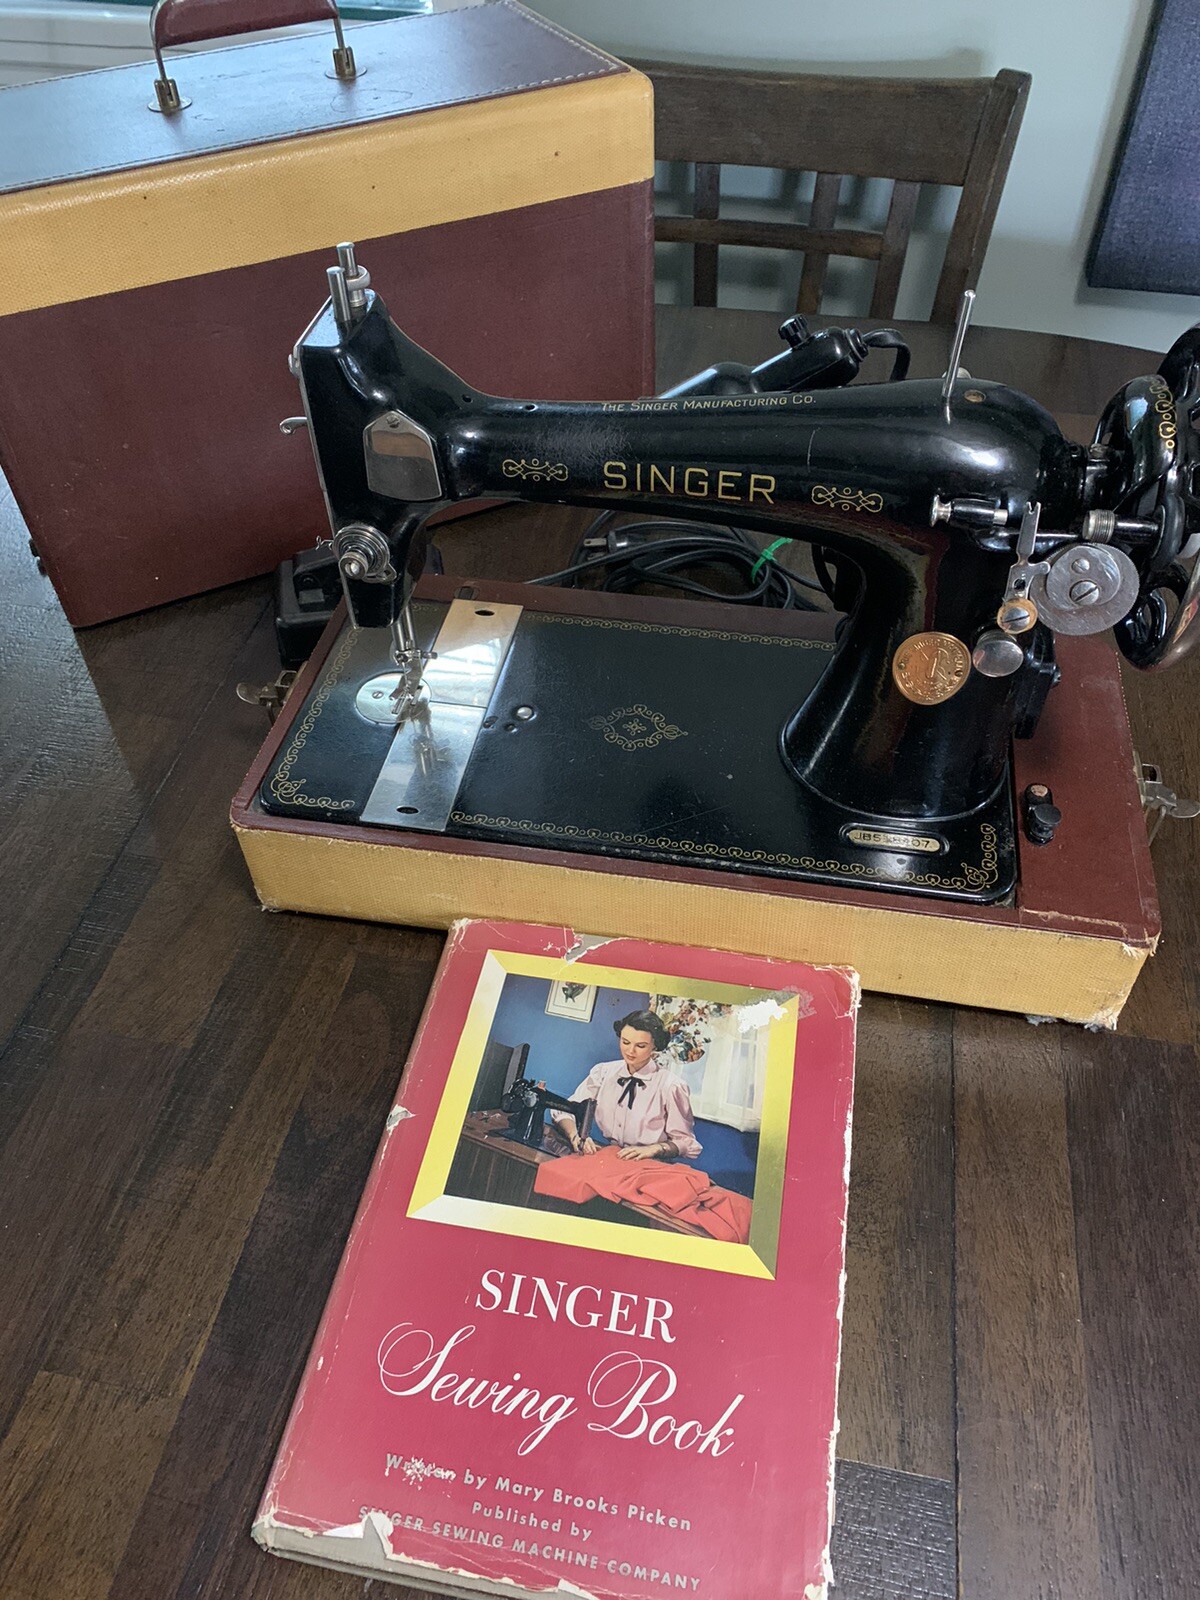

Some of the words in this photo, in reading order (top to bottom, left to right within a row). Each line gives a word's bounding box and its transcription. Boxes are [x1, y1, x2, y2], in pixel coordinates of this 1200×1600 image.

[601, 402, 626, 412] THE
[630, 401, 678, 412] SINGER
[683, 396, 788, 411] MANUFACTURING
[792, 395, 817, 405] CO.
[603, 460, 775, 505] SINGER
[475, 1268, 677, 1344] SINGER
[376, 1321, 578, 1456] Sewing
[586, 1350, 746, 1458] Book
[463, 1468, 487, 1489] by
[494, 1476, 545, 1502] Mary
[552, 1488, 620, 1516] Brooks
[627, 1504, 692, 1532] Picken
[471, 1501, 562, 1533] Published
[570, 1522, 593, 1541] by
[359, 1505, 424, 1532] SGER
[432, 1521, 504, 1549] SEWING
[511, 1538, 599, 1570] MACHINE
[607, 1559, 701, 1591] COMPANY
